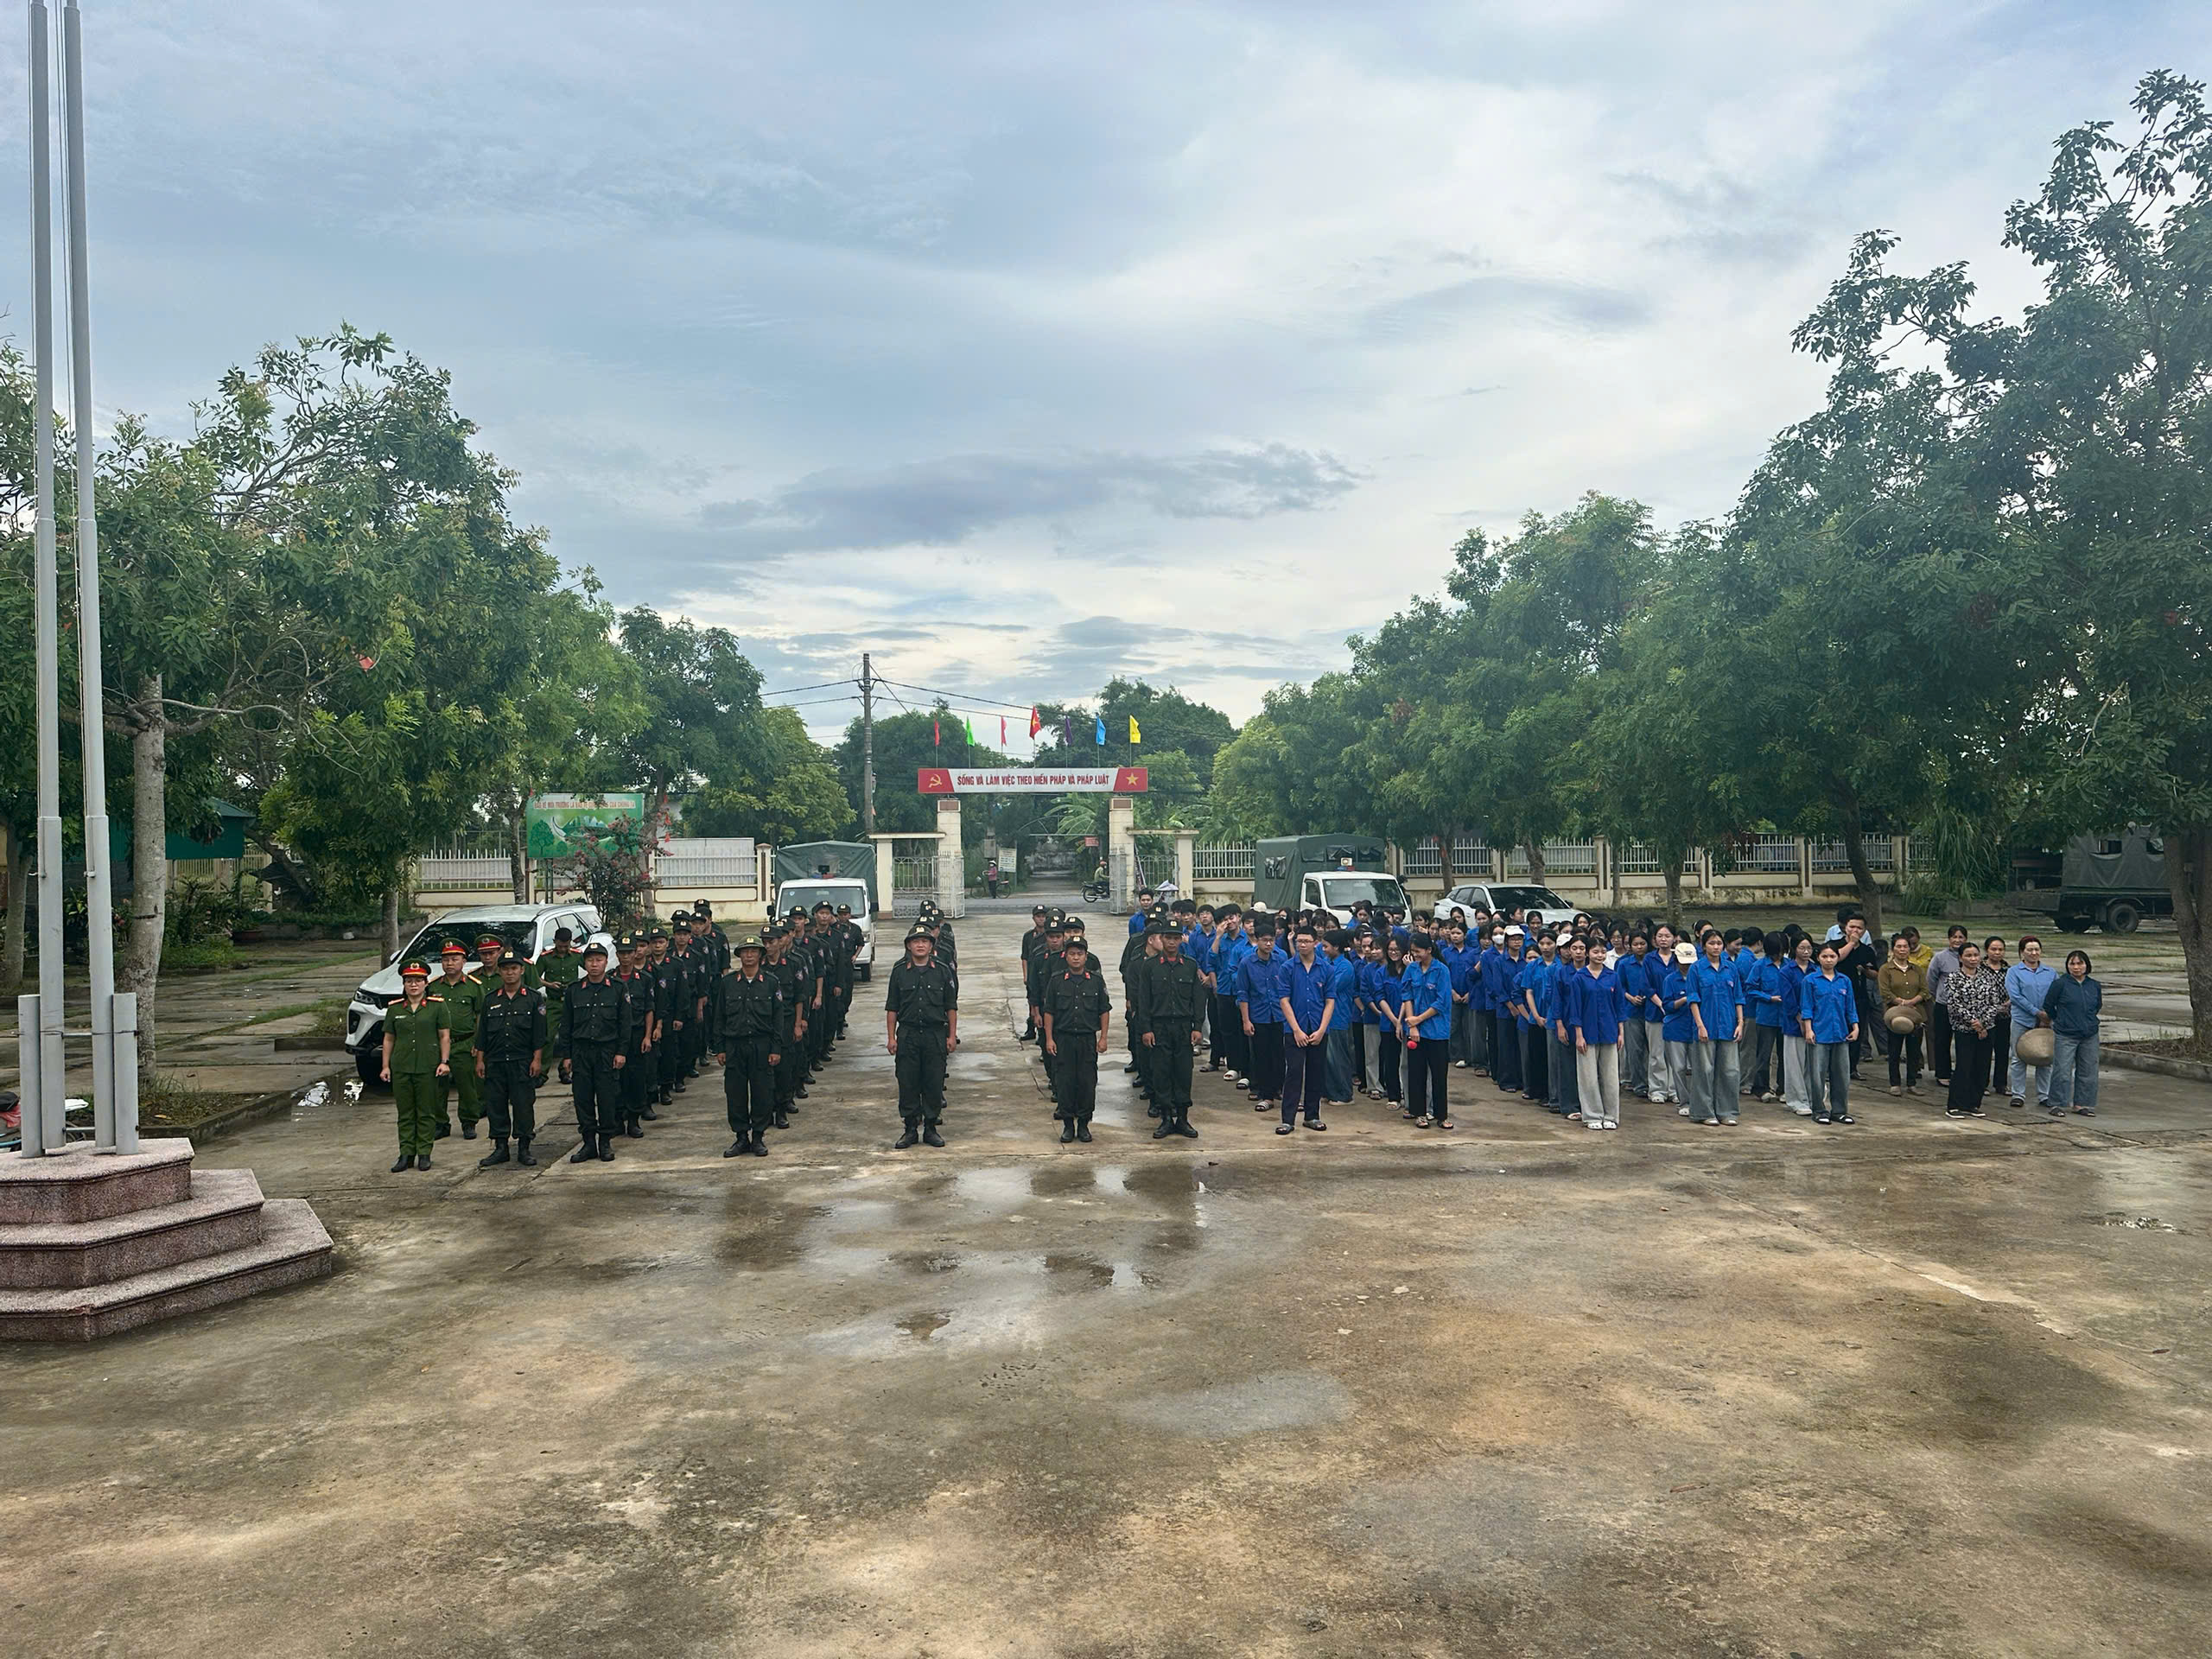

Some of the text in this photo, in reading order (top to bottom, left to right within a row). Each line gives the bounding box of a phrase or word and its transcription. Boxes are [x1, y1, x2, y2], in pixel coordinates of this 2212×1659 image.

[976, 774, 984, 785] VÀ
[986, 774, 1000, 785] LÀM
[1001, 773, 1015, 787] VIỆC
[1017, 775, 1033, 785] THEO
[1050, 773, 1066, 785] PHÁP
[1068, 773, 1076, 785] VÀ
[1077, 773, 1094, 785] PHÁP
